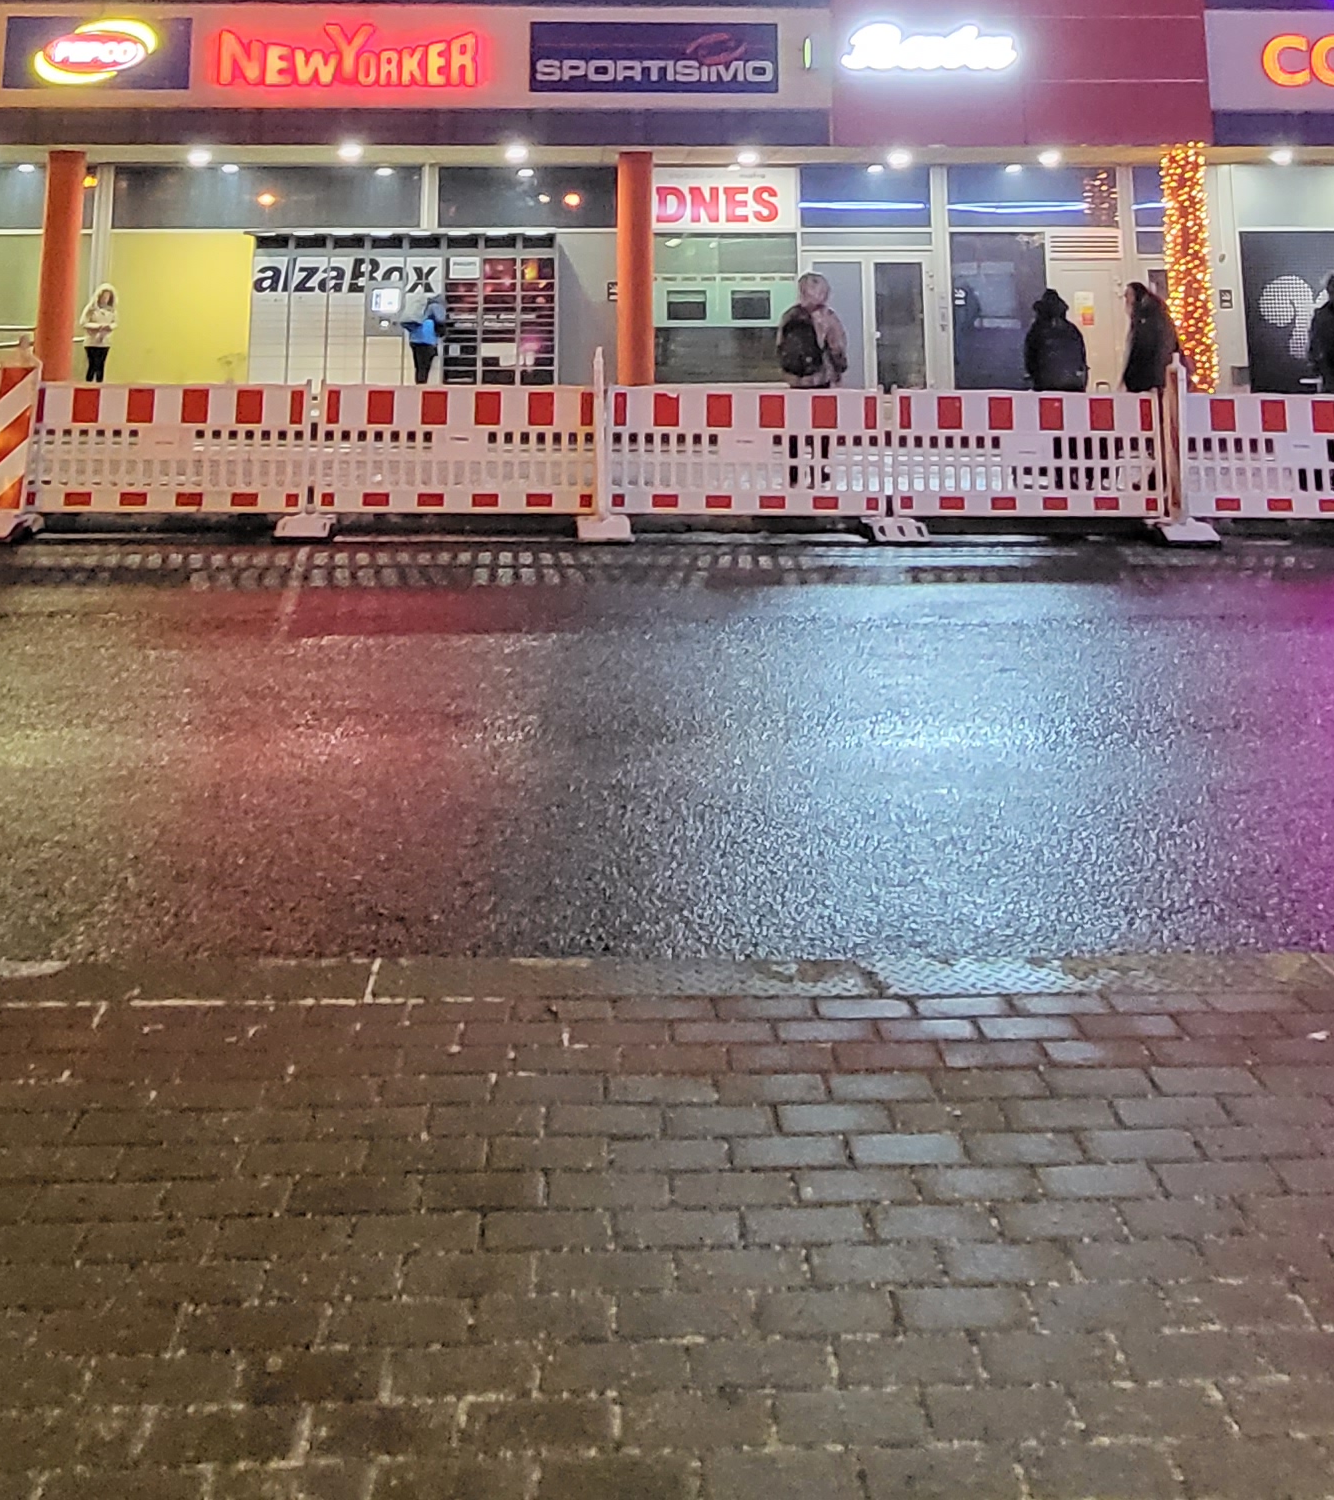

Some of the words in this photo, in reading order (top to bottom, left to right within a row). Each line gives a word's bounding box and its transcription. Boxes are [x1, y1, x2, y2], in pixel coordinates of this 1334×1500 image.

[533, 57, 776, 84] SPORTISIMO
[655, 185, 780, 224] DNES
[252, 256, 438, 294] alzaBox
